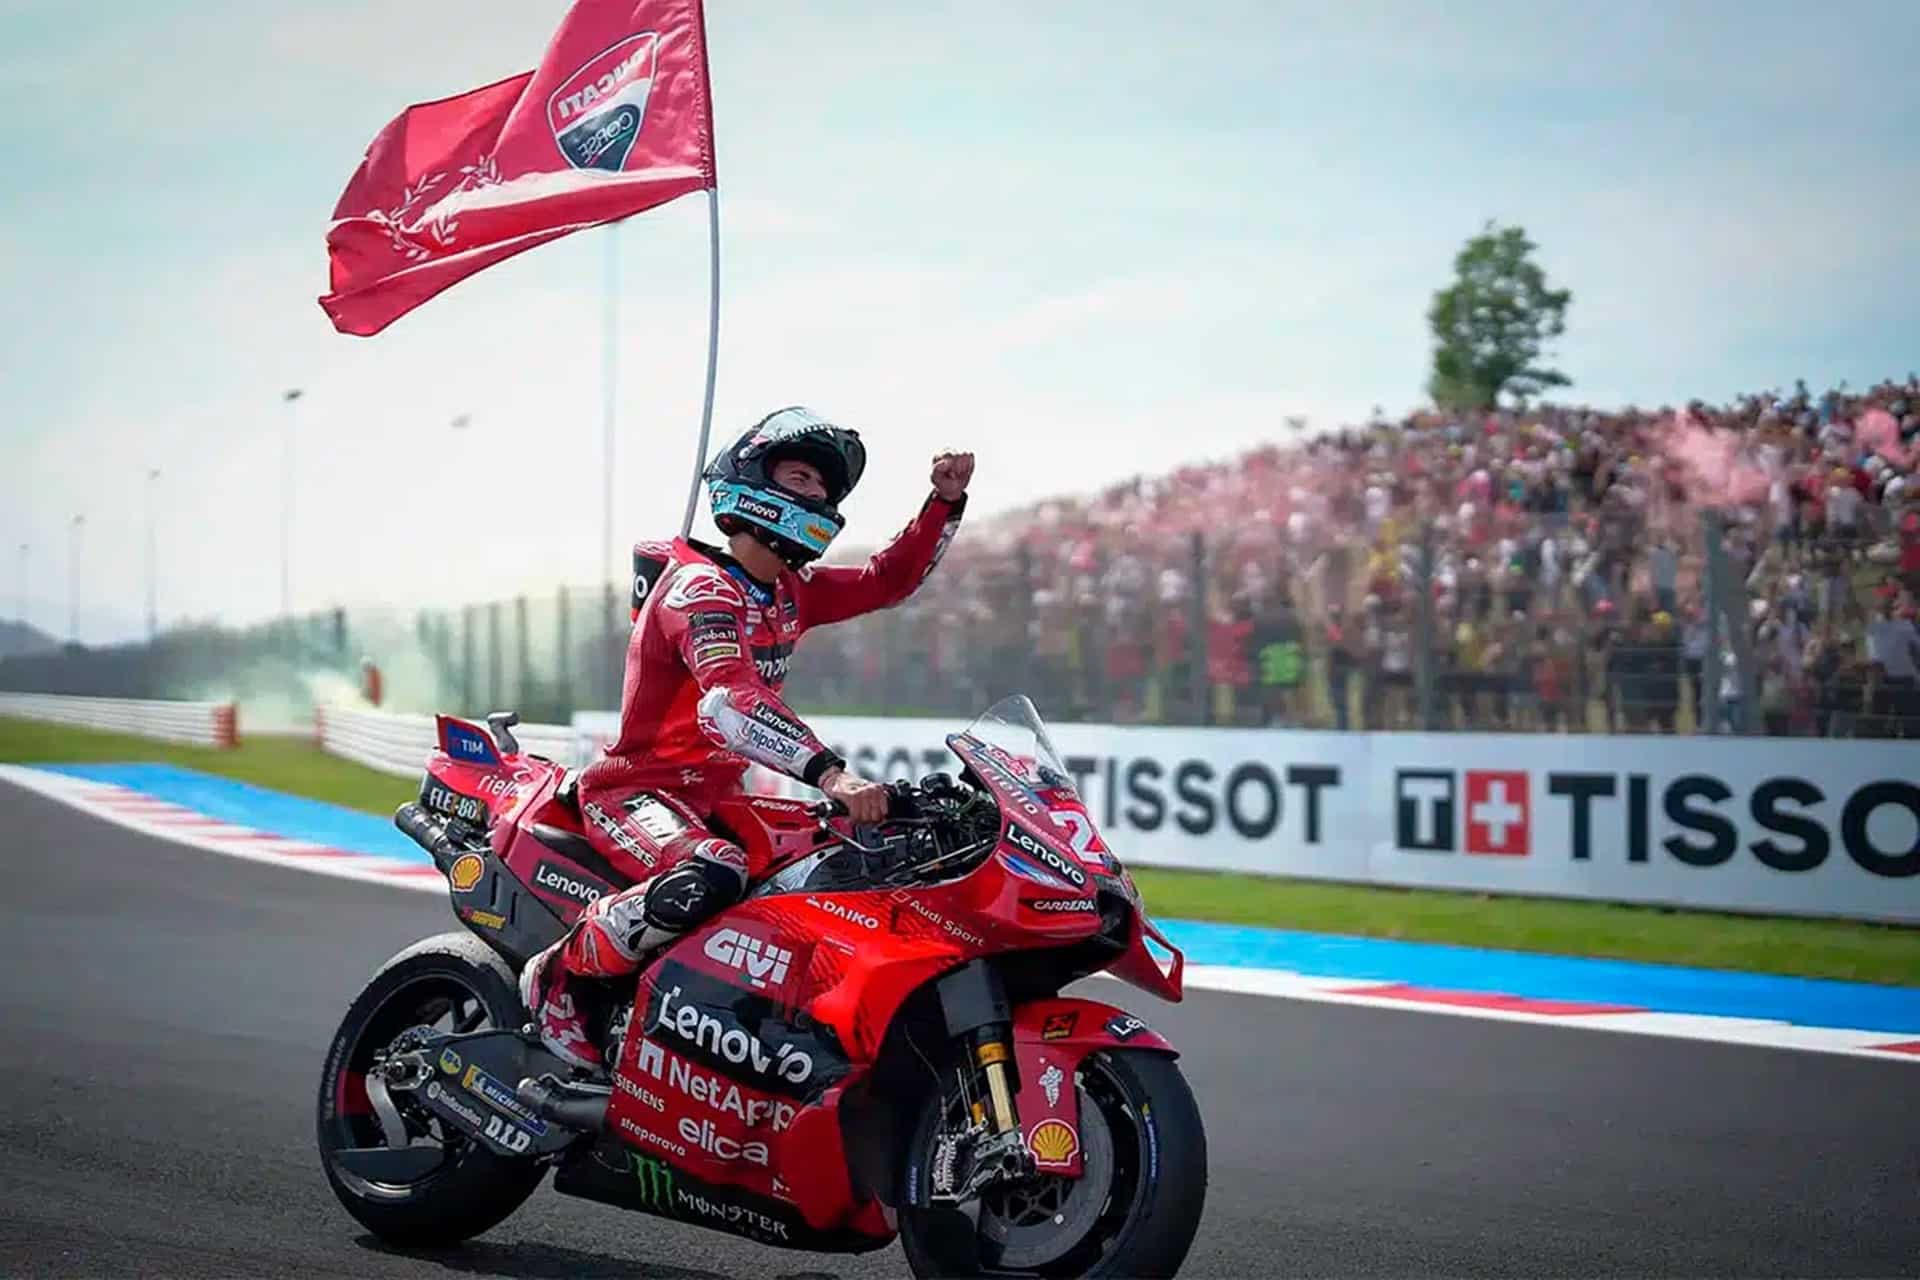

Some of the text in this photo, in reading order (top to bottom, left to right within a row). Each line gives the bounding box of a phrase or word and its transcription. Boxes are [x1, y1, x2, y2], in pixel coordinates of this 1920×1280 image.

[738, 496, 779, 519] Lenovo
[460, 738, 484, 755] TIM
[756, 704, 806, 740] Lenovo
[1064, 755, 1341, 843] TISSOT
[1548, 771, 1920, 878] TISSO
[1006, 824, 1086, 885] Lenovo
[536, 863, 600, 905] Lenovo
[1033, 899, 1096, 912] CARRERA
[909, 899, 987, 948] Audi Sport
[657, 984, 814, 1084] Lenovo
[614, 1072, 666, 1113] SIEMENS
[668, 1056, 796, 1133] NetApp
[620, 1116, 687, 1157] streparava
[678, 1116, 770, 1167] elica
[676, 1188, 791, 1241] MONSTER
